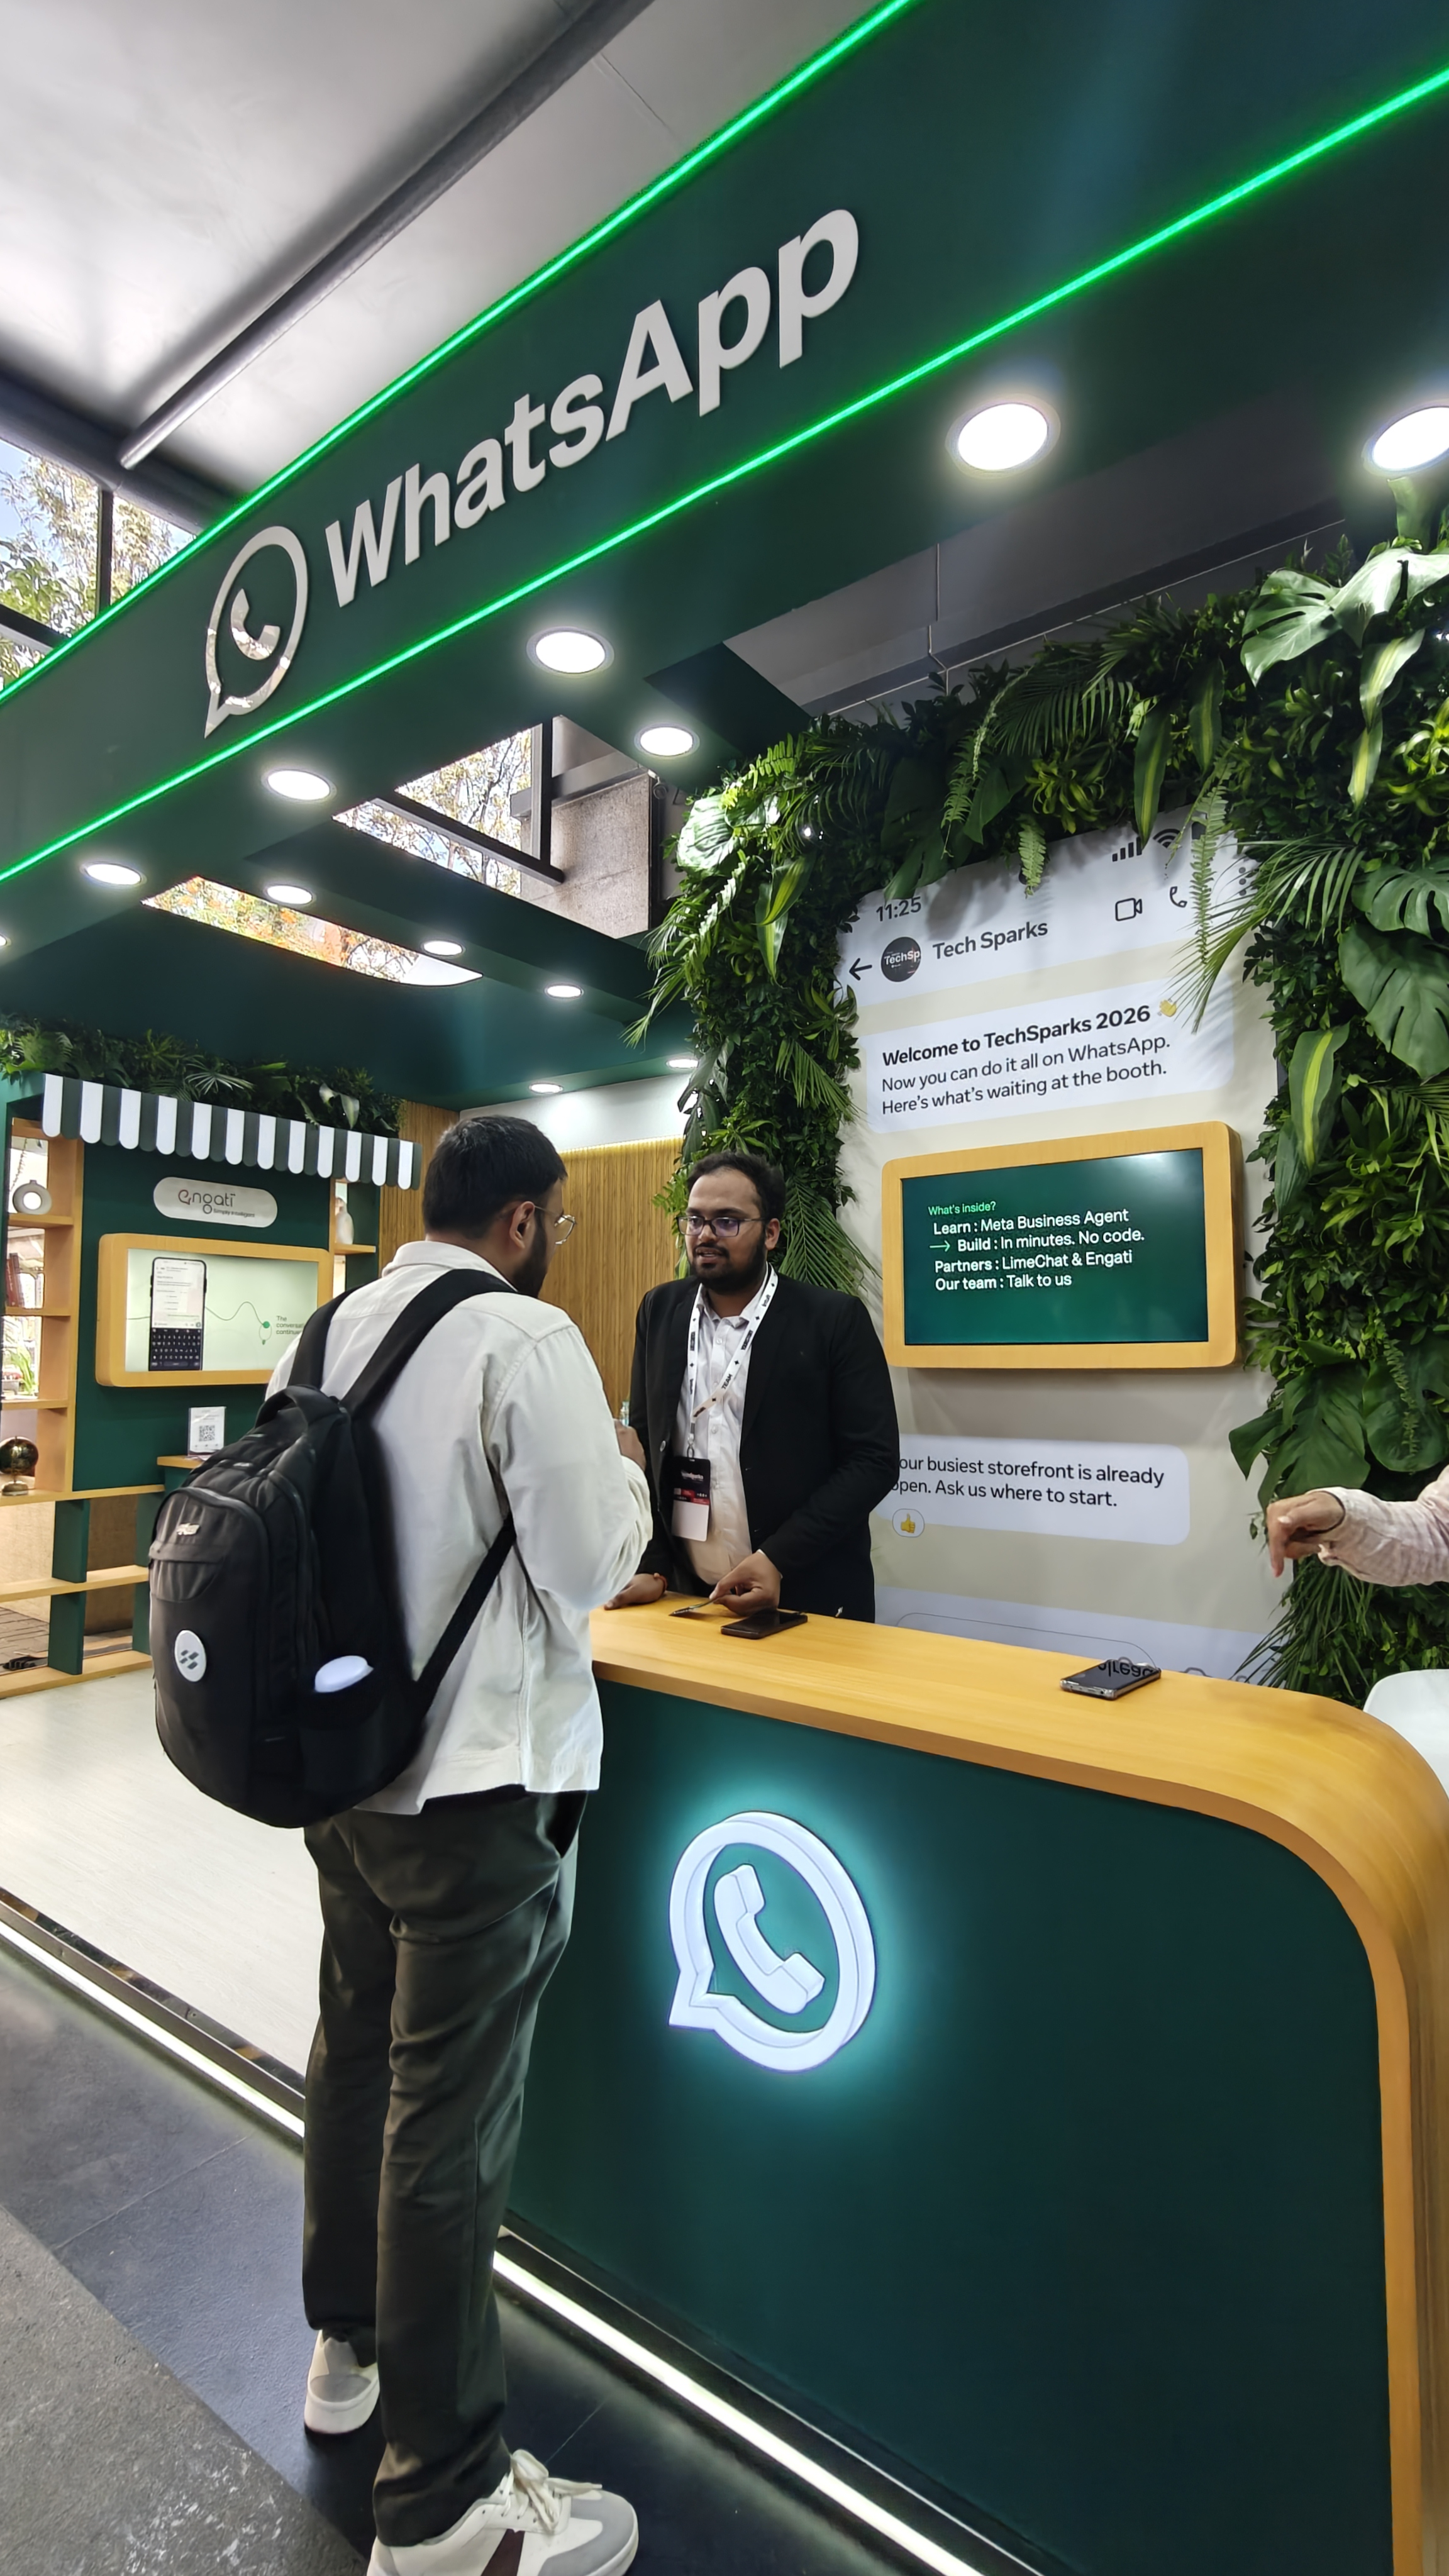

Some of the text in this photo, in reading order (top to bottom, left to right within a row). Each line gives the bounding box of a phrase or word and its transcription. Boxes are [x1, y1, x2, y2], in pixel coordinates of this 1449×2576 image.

[324, 208, 860, 608] WhatsApp
[875, 896, 922, 922] 11:25
[933, 921, 1048, 959] Tech Sparks
[882, 1005, 1150, 1066] Welcome to TechSparks 2026
[882, 1037, 1170, 1092] Now you can do it all on WhatsApp.
[882, 1060, 1167, 1115] Here’s what’s waiting at the booth.
[928, 1201, 996, 1216] What's inside?
[933, 1222, 971, 1235] Learn
[980, 1218, 1014, 1231] Meta
[1018, 1214, 1080, 1229] Business
[1084, 1208, 1130, 1226] Agent
[957, 1237, 991, 1252] Build
[1001, 1236, 1013, 1249] In
[1016, 1234, 1075, 1248] minutes.
[1079, 1230, 1099, 1245] No
[1102, 1228, 1145, 1243] code.
[935, 1260, 992, 1274] Partners
[1002, 1254, 1069, 1269] LimeChat
[1071, 1252, 1083, 1266] &
[1085, 1250, 1132, 1268] Engati
[935, 1278, 960, 1291] Our
[962, 1277, 997, 1289] team
[1006, 1274, 1034, 1288] Talk
[1036, 1274, 1052, 1287] to
[1055, 1274, 1072, 1286] us
[721, 1374, 733, 1389] TEAM
[899, 1455, 1165, 1489] our busiest storefront is already
[935, 1480, 965, 1496] Ask
[968, 1485, 987, 1497] us
[990, 1483, 1043, 1501] where
[1046, 1487, 1065, 1502] to
[1069, 1489, 1118, 1507] start.
